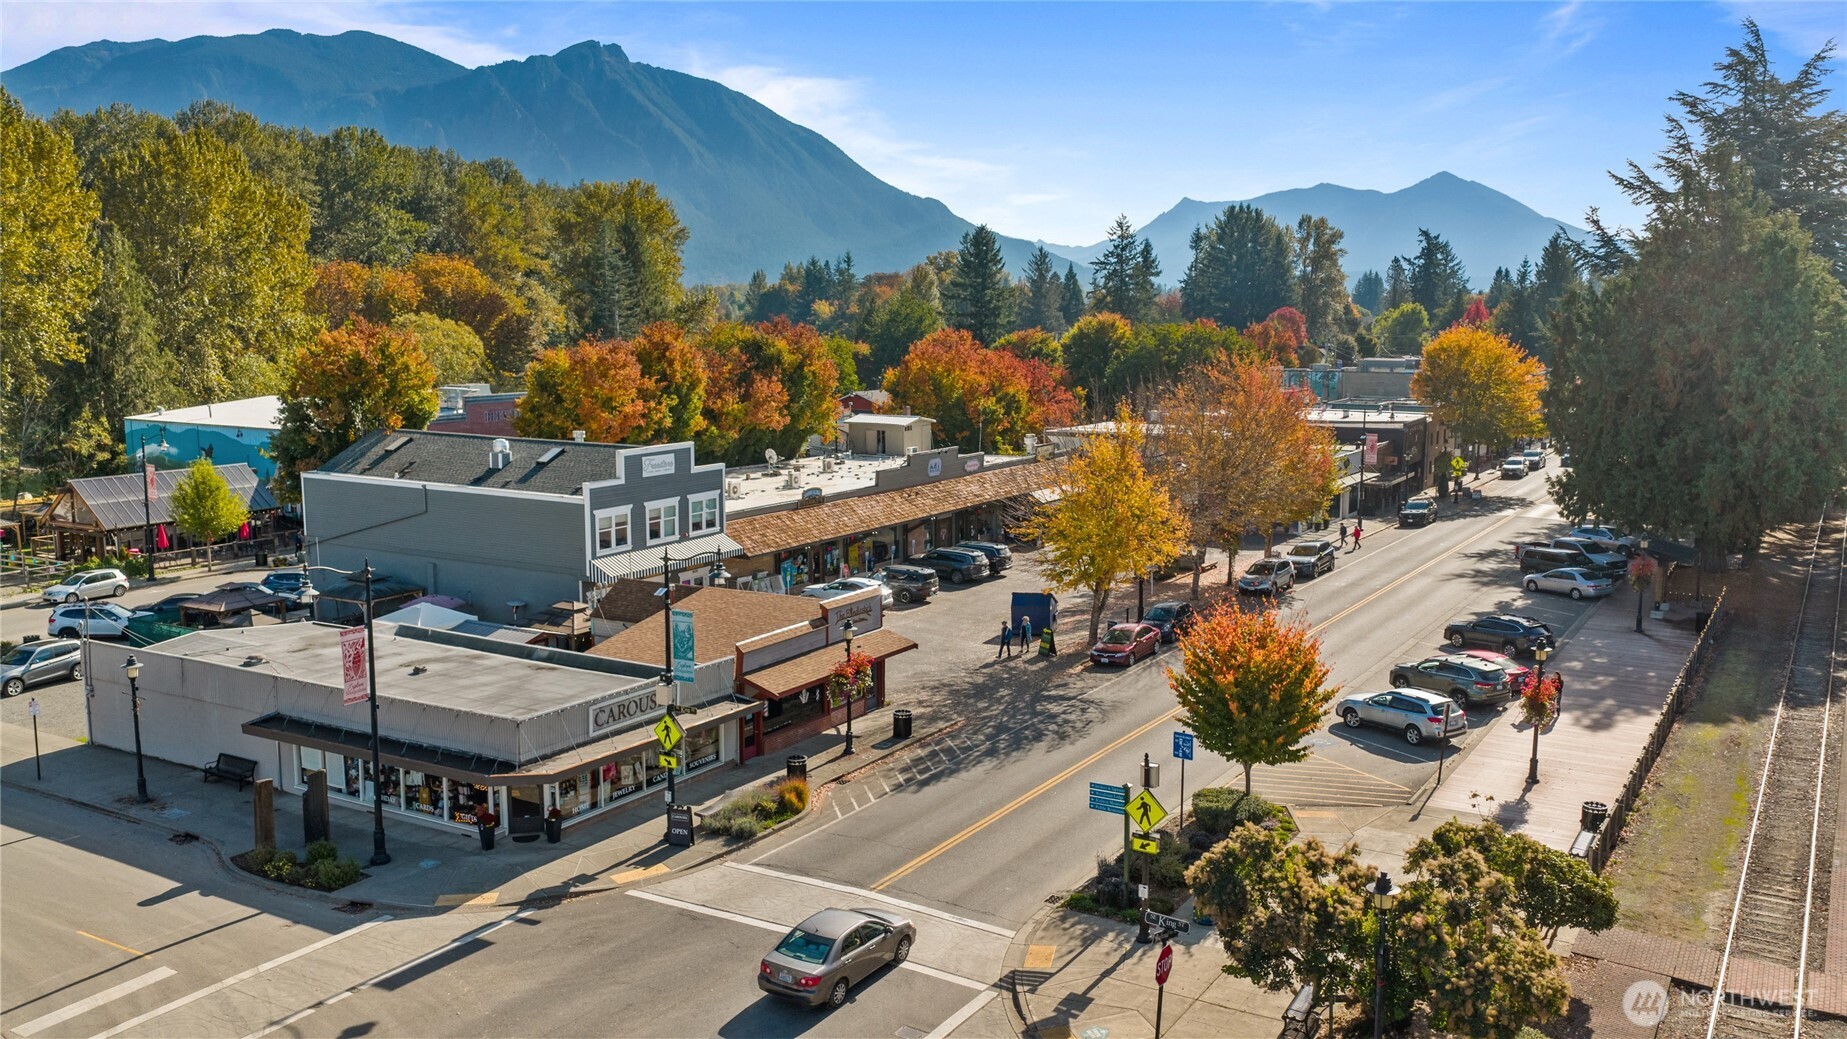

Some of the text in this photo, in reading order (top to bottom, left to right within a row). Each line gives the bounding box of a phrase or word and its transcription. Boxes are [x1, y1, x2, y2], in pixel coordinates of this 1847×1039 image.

[594, 693, 661, 727] CAROUS
[689, 754, 717, 768] SOUVENIRS
[612, 784, 635, 800] JEWELRY
[415, 802, 434, 813] CARDS
[671, 828, 689, 836] OPEN
[1150, 913, 1157, 921] SE
[1158, 915, 1177, 930] King
[1156, 954, 1172, 978] STOP
